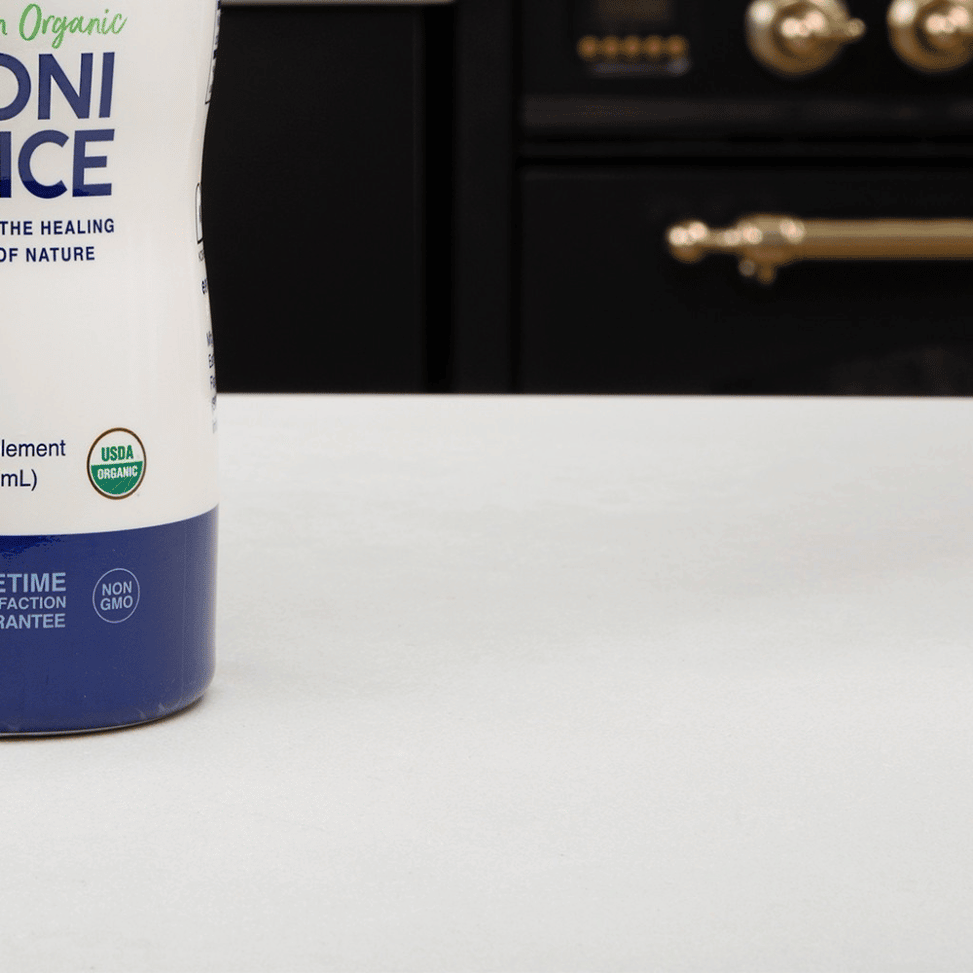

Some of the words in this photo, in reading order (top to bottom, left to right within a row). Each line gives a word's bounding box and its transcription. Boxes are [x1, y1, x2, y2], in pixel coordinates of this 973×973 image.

[18, 3, 128, 49] Organic
[40, 218, 115, 235] HEALING
[25, 246, 95, 262] NATURE
[100, 444, 134, 462] USDA
[0, 468, 38, 491] mL)
[97, 464, 138, 480] ORGANIC
[101, 581, 133, 597] NON
[100, 595, 134, 611] GMO
